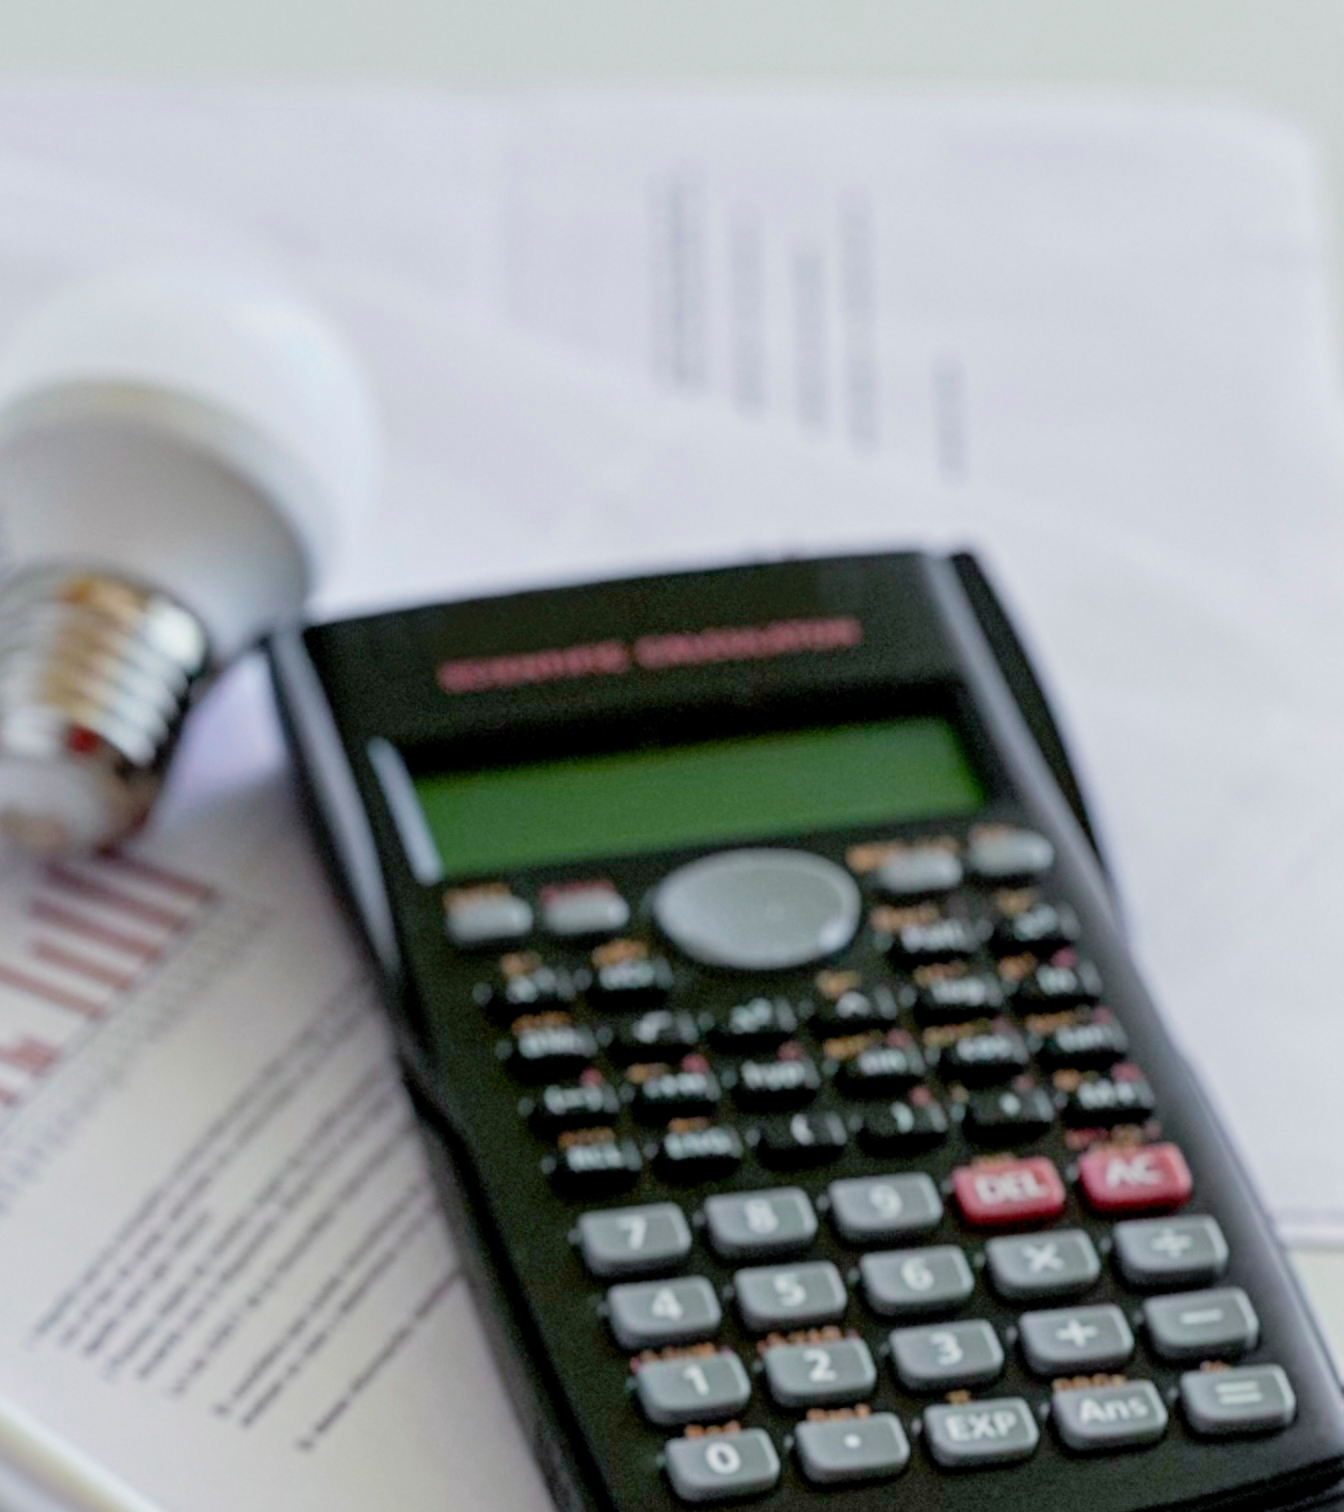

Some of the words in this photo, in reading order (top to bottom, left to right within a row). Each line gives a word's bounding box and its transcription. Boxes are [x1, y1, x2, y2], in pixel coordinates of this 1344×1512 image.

[1105, 1156, 1161, 1186] AC
[868, 1185, 902, 1219] 9
[973, 1172, 1045, 1203] DEL
[617, 1215, 647, 1250] 7
[744, 1199, 778, 1234] 8
[773, 1273, 806, 1306] 5
[900, 1257, 935, 1291] 6
[651, 1289, 683, 1320] 4
[930, 1332, 964, 1366] 3
[682, 1364, 710, 1396] 1
[803, 1350, 837, 1382] 2
[1079, 1397, 1149, 1424] Ans
[946, 1412, 1016, 1442] EXP
[705, 1442, 741, 1474] 0
